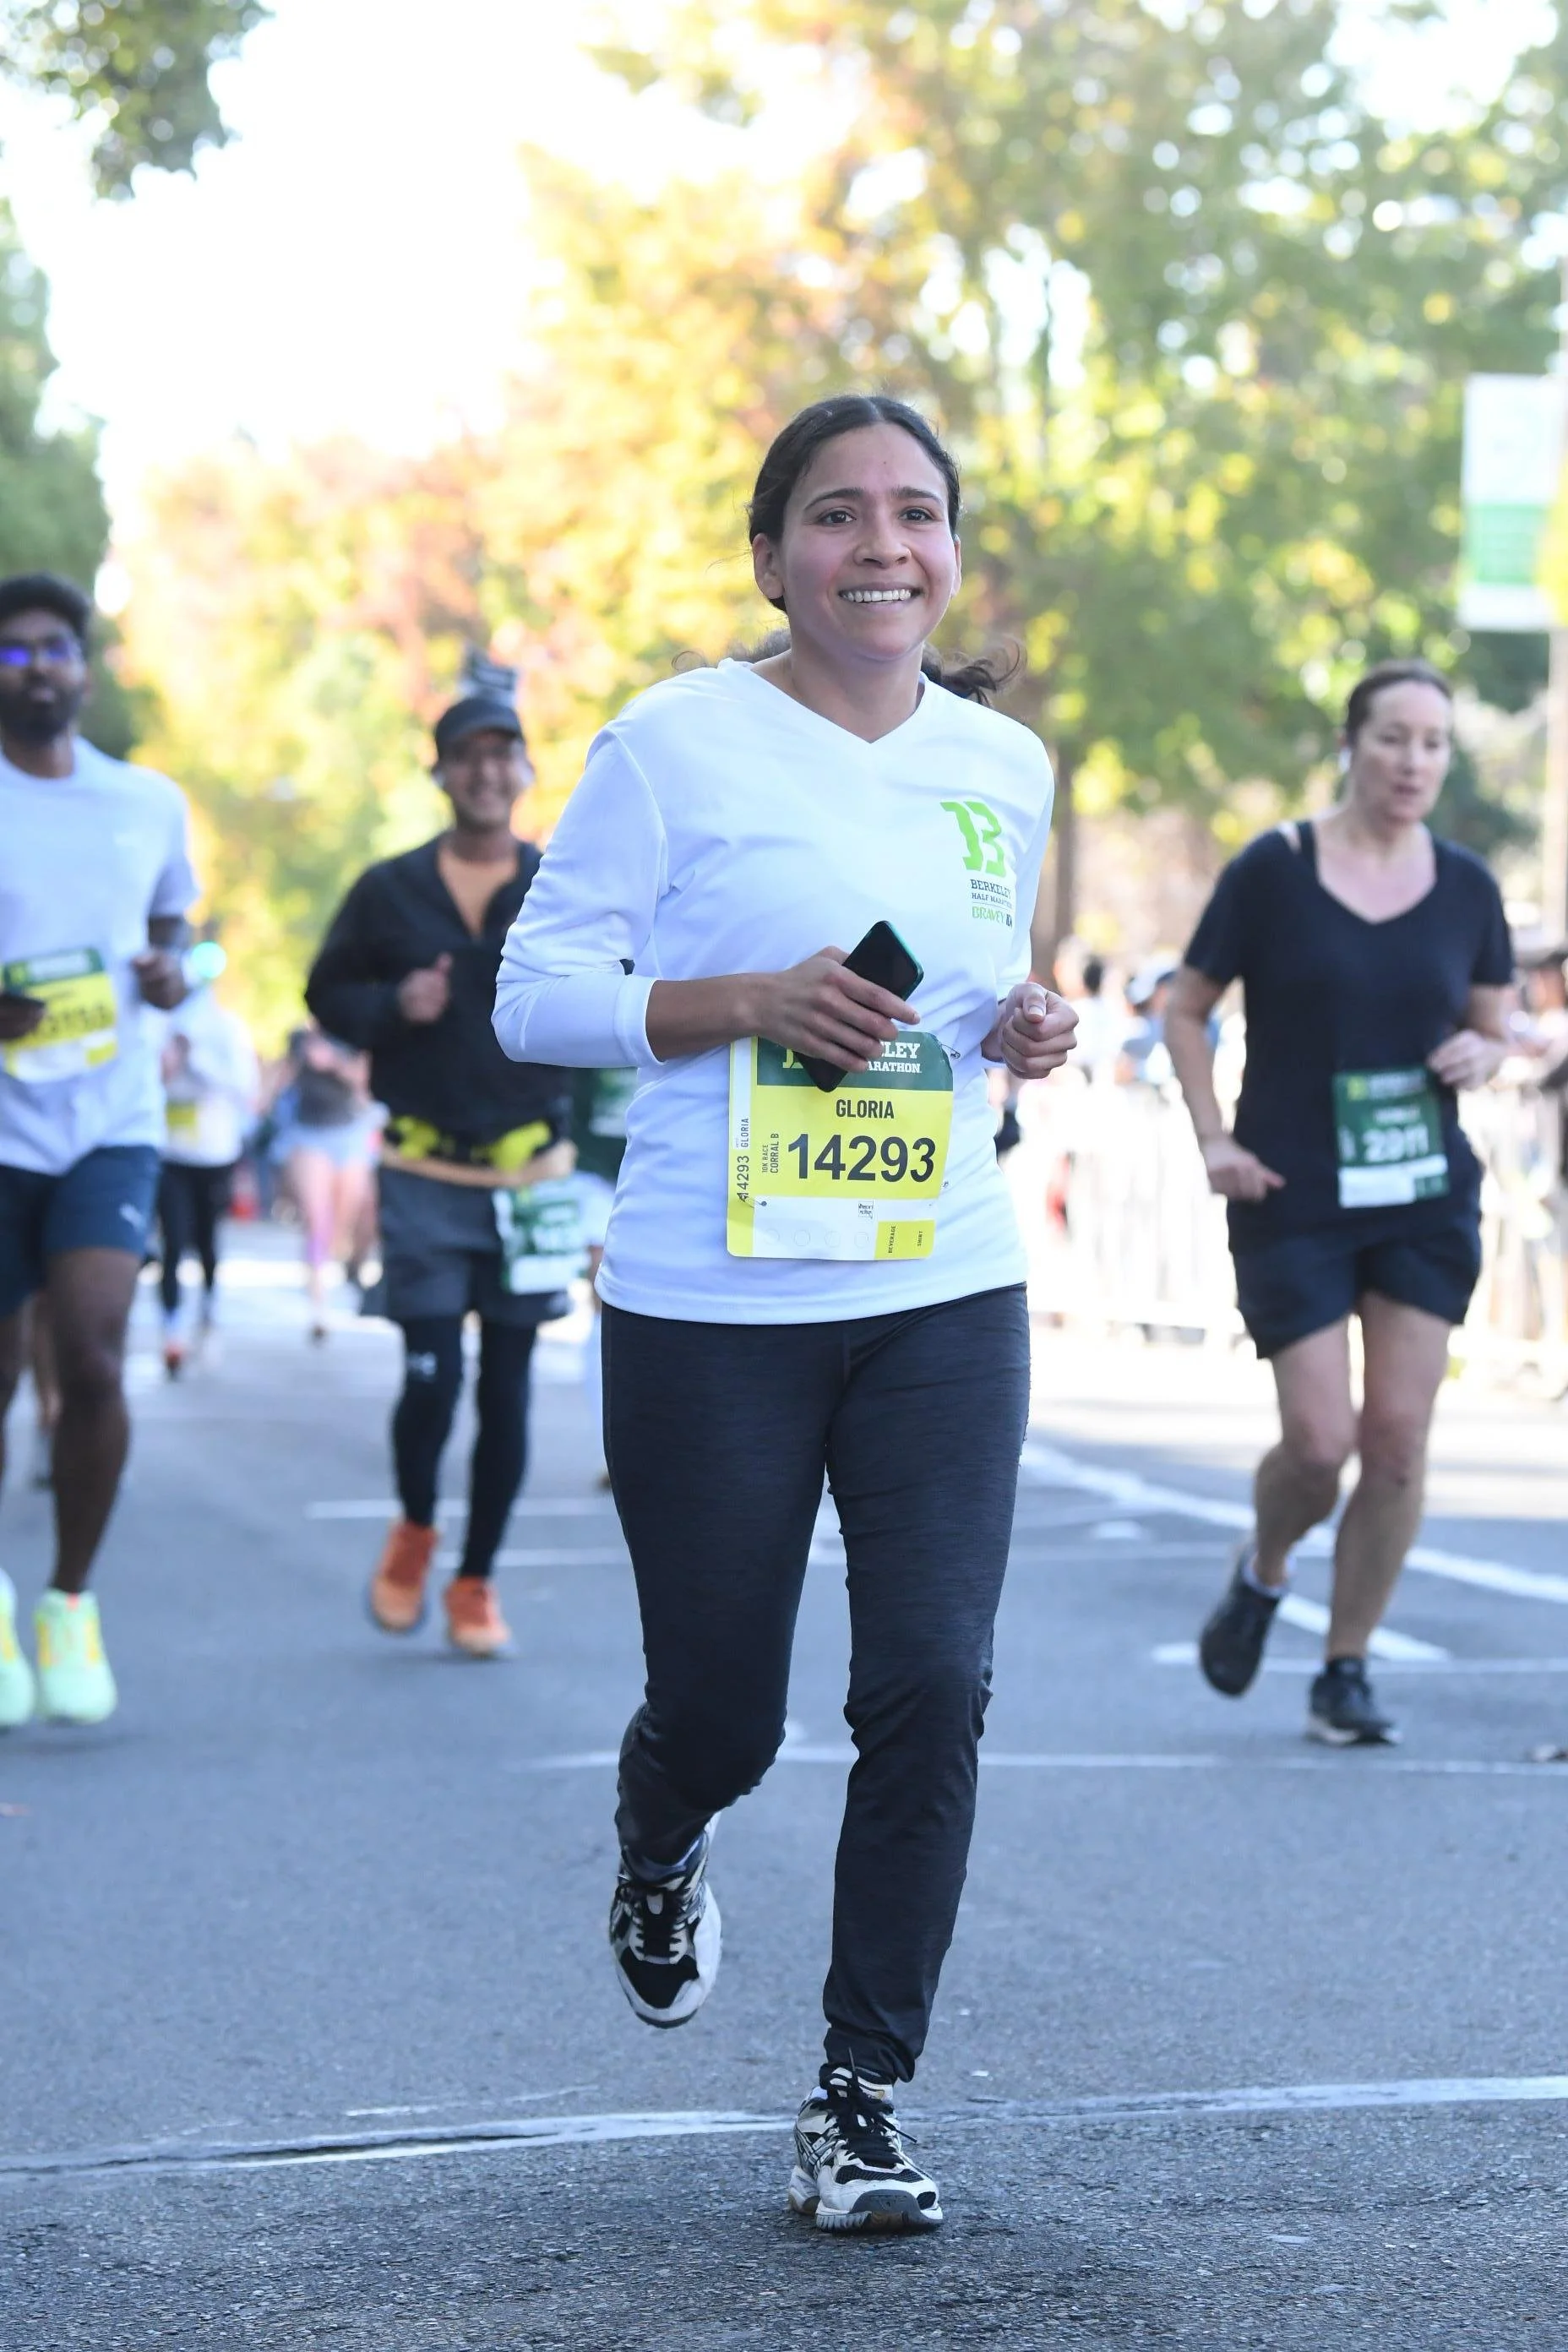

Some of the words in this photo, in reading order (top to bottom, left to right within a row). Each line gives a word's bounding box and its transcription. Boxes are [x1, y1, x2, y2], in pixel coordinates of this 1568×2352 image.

[970, 879, 1011, 900] BERKELEY
[972, 892, 989, 901] HALF
[867, 1063, 923, 1074] ARATHON
[836, 1099, 895, 1119] GLORIA
[740, 1118, 749, 1148] GLORIA
[770, 1141, 779, 1173] CORRAL
[787, 1133, 936, 1183] 14293
[888, 1225, 896, 1254] BEVERAGE
